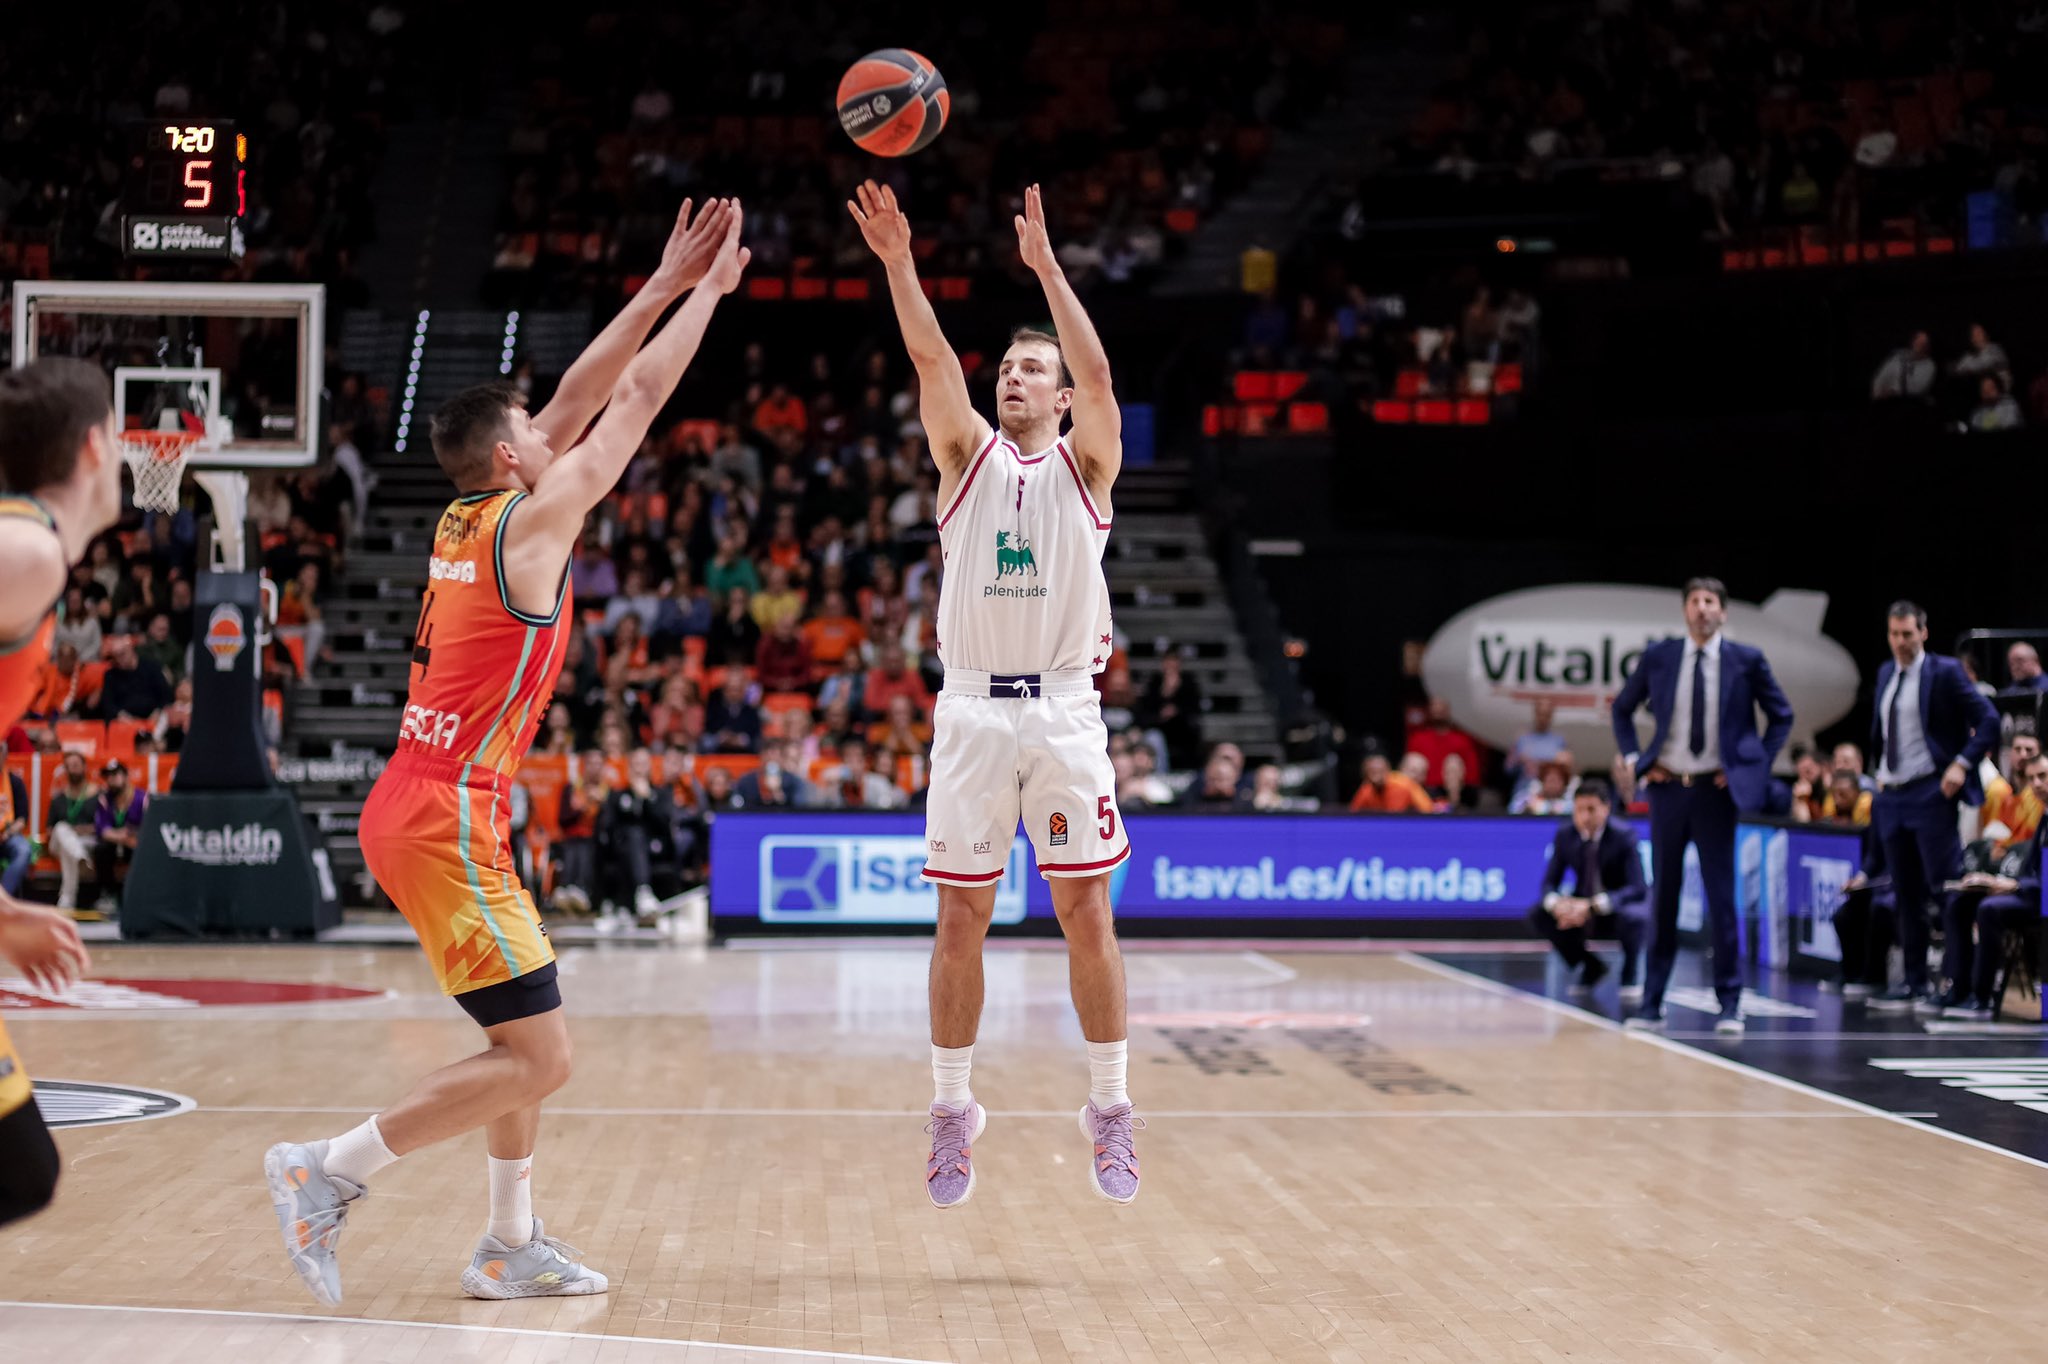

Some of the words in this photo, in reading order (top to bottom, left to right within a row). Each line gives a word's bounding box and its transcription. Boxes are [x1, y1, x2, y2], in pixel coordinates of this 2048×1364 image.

[184, 160, 212, 208] 5
[984, 584, 1048, 598] plenitude
[1097, 796, 1115, 840] 5
[160, 821, 283, 855] Vitaldin
[973, 841, 991, 852] EA7
[1153, 856, 1506, 901] isaval.es/tiendas
